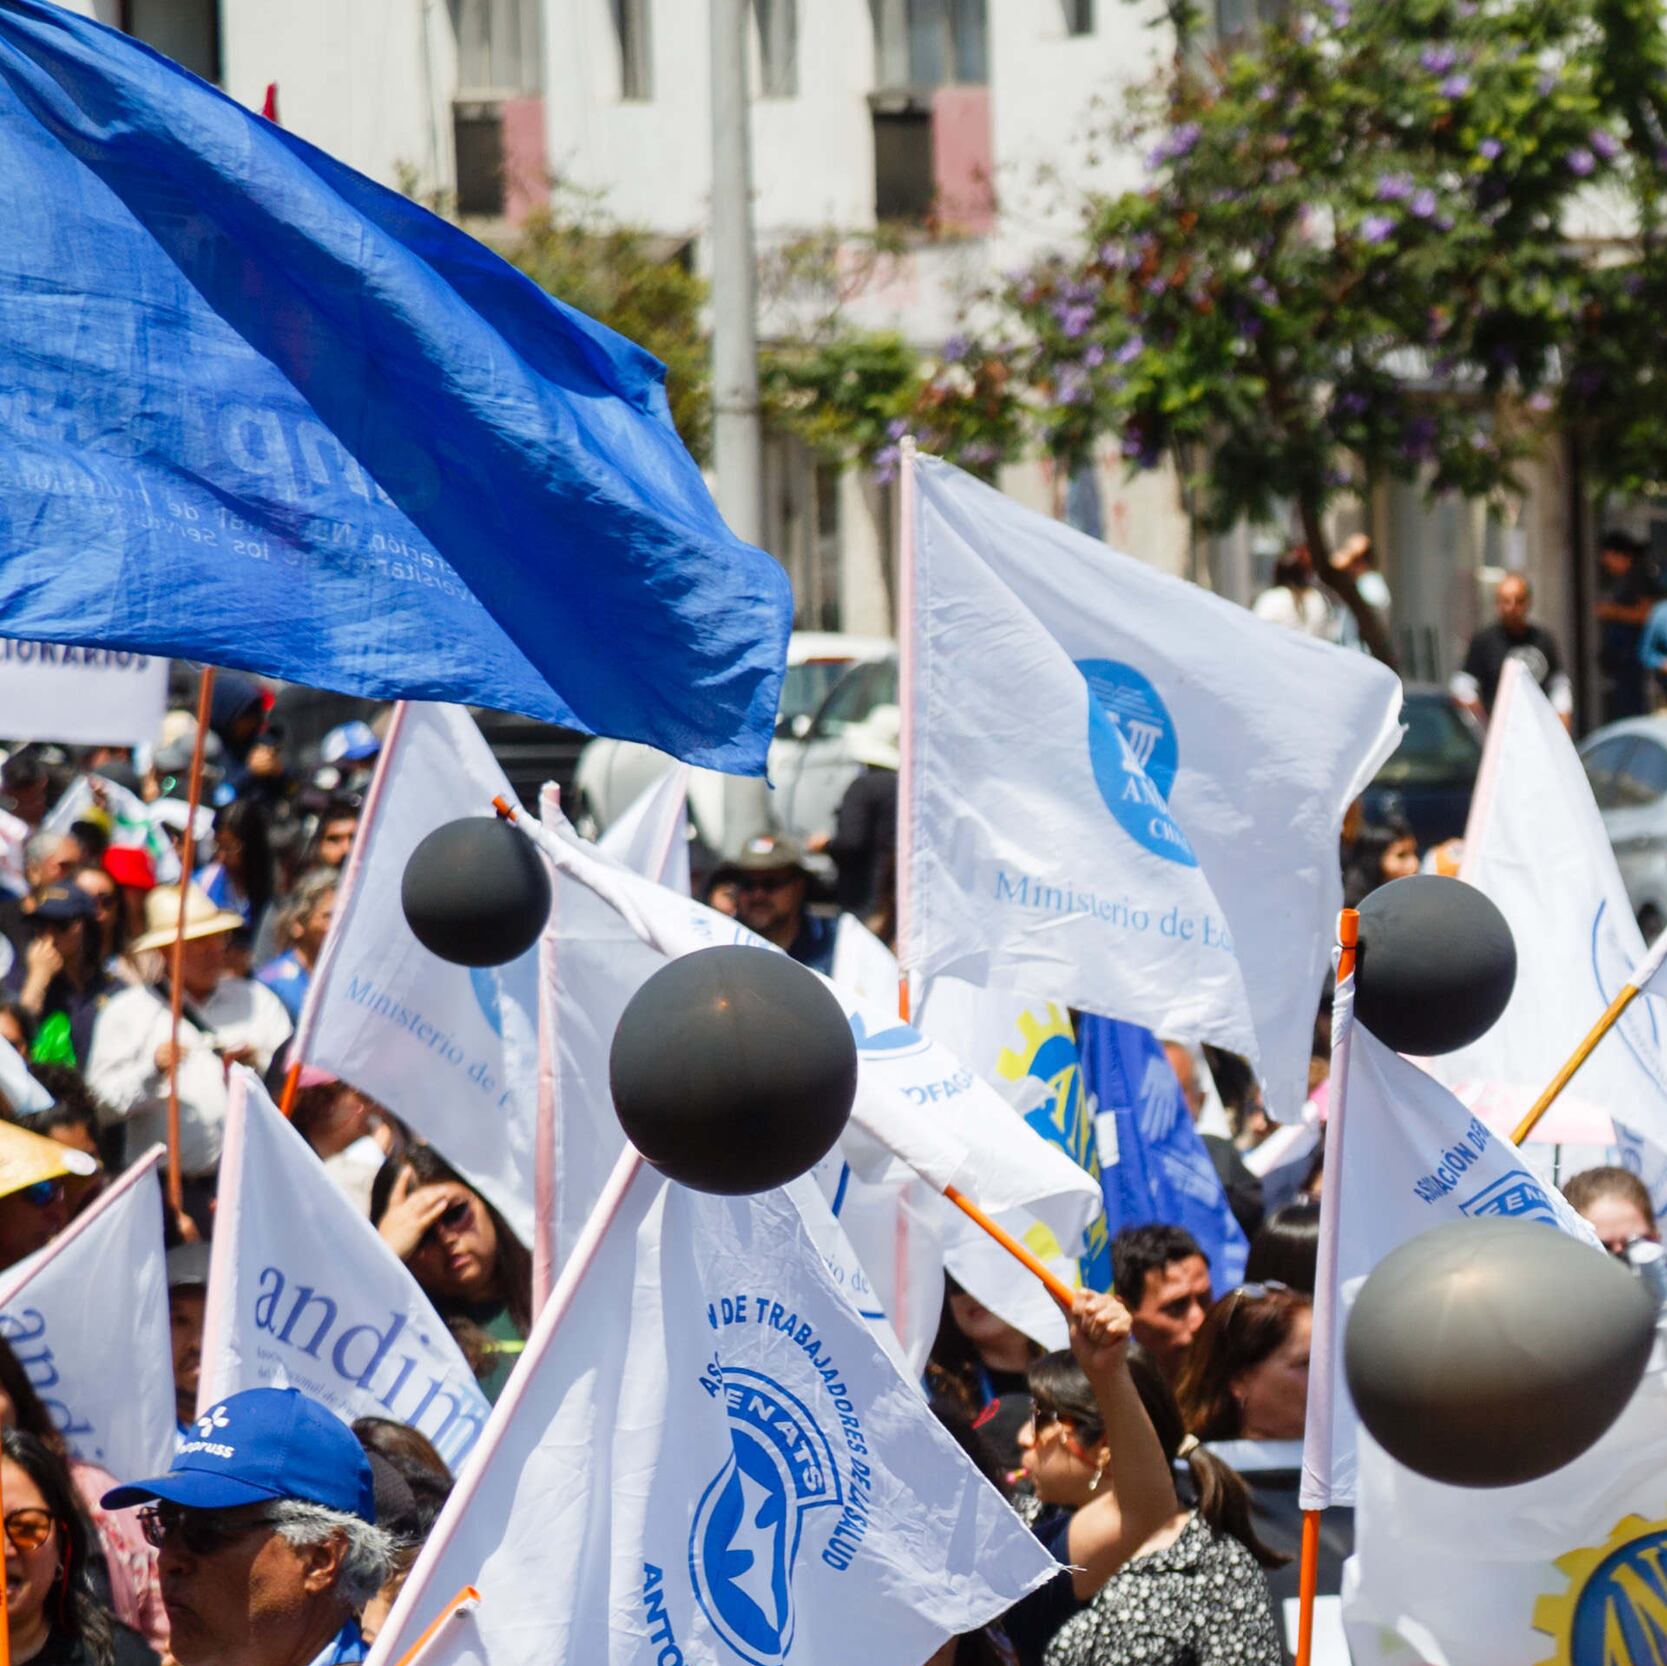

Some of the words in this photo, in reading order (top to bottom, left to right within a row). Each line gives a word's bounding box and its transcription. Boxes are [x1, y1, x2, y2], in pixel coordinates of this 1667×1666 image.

[994, 869, 1149, 932] Ministerio
[1159, 906, 1194, 941] de
[344, 975, 464, 1066] Ministerio
[721, 1296, 747, 1325] DE
[756, 1297, 868, 1455] TRABAJADORES
[727, 1389, 824, 1493] ENATS
[850, 1457, 872, 1490] DE
[822, 1505, 868, 1571] SALUD
